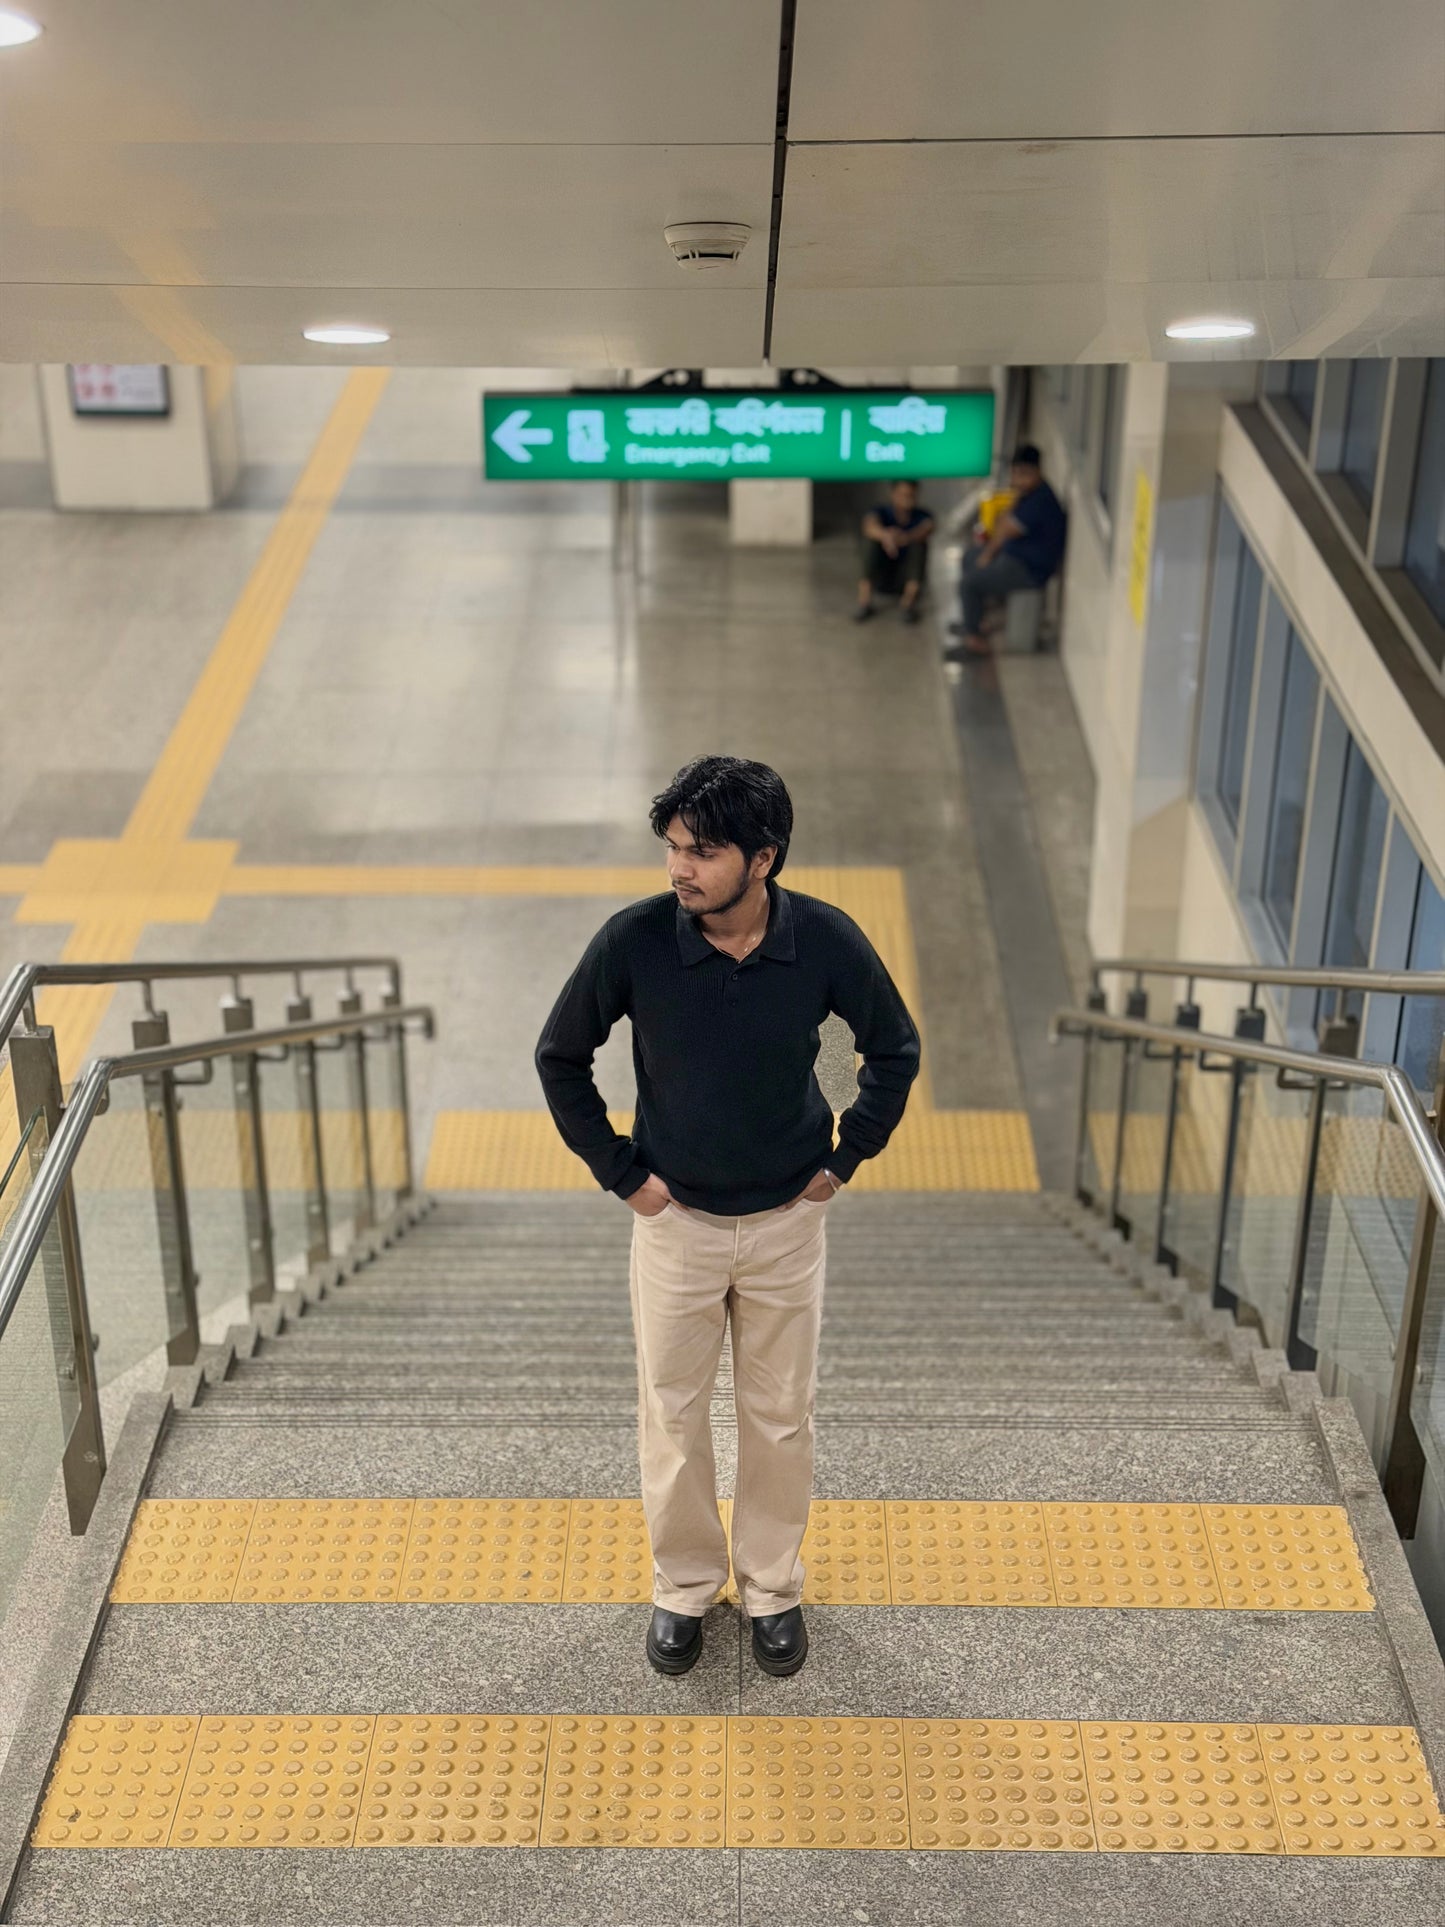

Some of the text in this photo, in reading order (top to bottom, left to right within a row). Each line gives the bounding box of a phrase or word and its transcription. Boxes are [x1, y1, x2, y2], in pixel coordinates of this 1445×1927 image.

[626, 443, 769, 466] Emergency Exit
[866, 442, 904, 461] Exit
